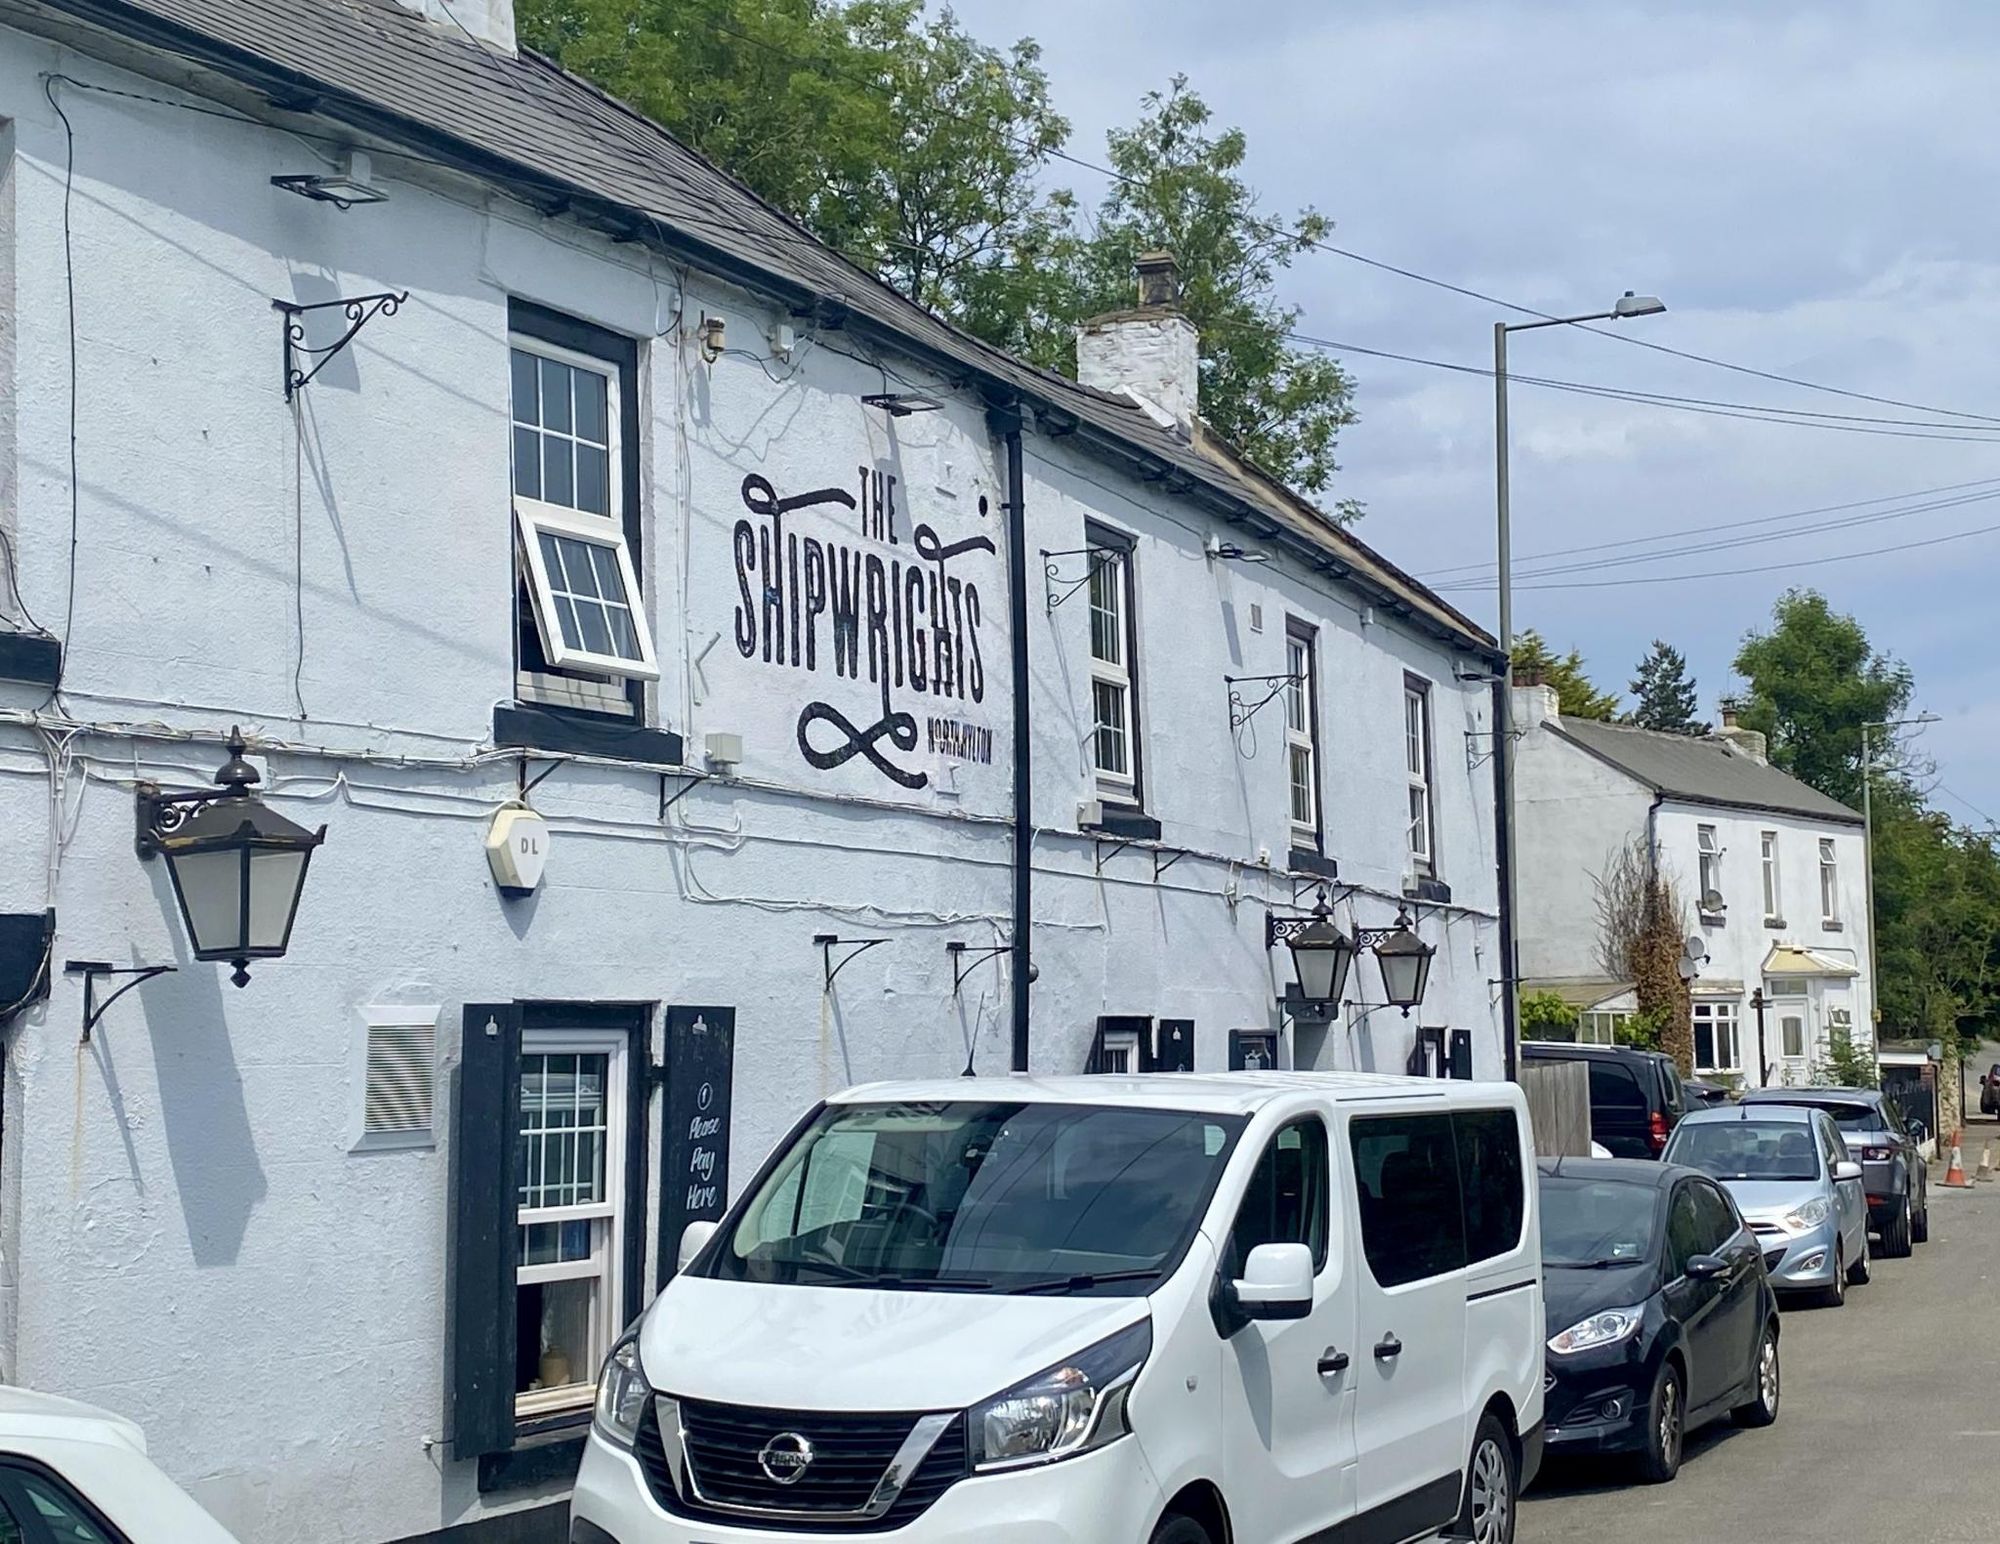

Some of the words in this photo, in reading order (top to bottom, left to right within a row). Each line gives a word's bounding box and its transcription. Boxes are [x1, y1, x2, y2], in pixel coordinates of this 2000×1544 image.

[859, 466, 898, 544] THE
[734, 473, 996, 789] SHIPWRIGHTS
[688, 1116, 720, 1140] Please
[690, 1147, 715, 1182] Pay
[686, 1184, 717, 1210] Here
